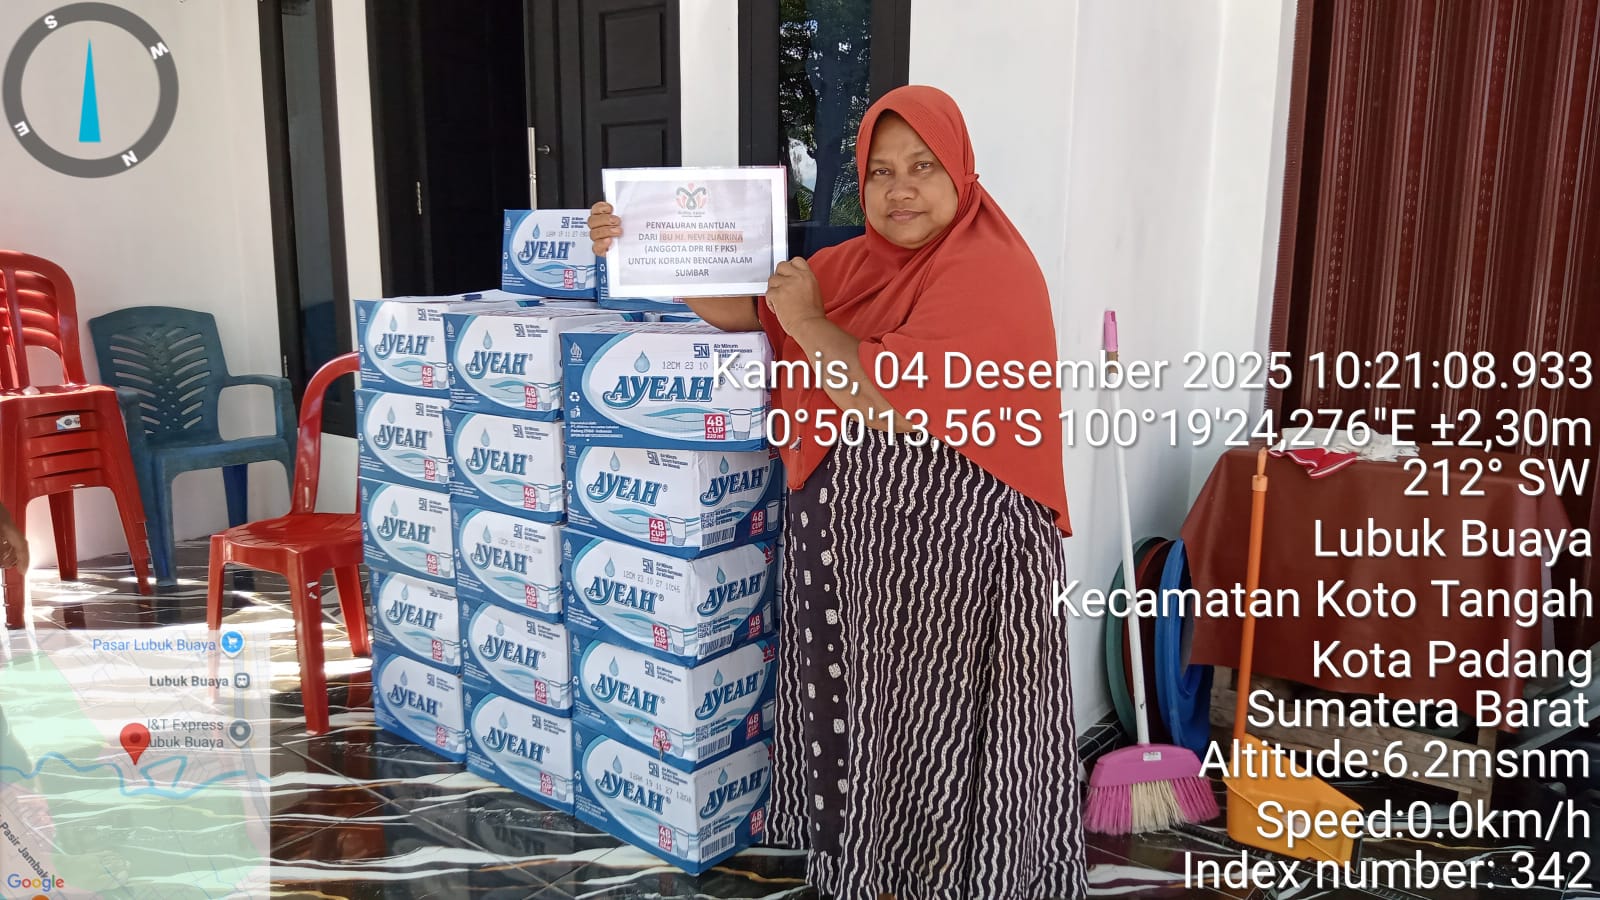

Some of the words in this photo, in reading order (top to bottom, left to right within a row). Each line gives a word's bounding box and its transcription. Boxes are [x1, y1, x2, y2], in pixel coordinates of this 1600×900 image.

[646, 221, 697, 230] PENYALURAN
[699, 221, 736, 230] BANTUAN
[638, 233, 658, 241] DARI
[518, 240, 571, 266] AYEAH
[644, 245, 687, 255] (ANGGOTA
[720, 245, 737, 255] PKS)
[628, 258, 657, 266] UNTUK
[658, 257, 691, 265] KORBAN
[693, 256, 729, 265] BENCANA
[731, 256, 753, 264] ALAM
[675, 268, 709, 278] SUMBAR
[374, 333, 430, 360] AYEAH
[693, 343, 710, 358] SNI
[422, 366, 432, 376] 48
[465, 351, 528, 379] AYEAH
[684, 361, 694, 370] 23
[699, 362, 708, 370] 10
[525, 387, 536, 397] 48
[602, 375, 714, 410] AYEAH
[706, 416, 723, 427] 48
[707, 426, 724, 434] CUP
[374, 424, 428, 450] AYEAH
[424, 460, 434, 470] 48
[466, 447, 528, 476] AYEAH
[524, 487, 535, 497] 48
[586, 471, 662, 507] AYEAH
[700, 466, 765, 507] AYEAH
[752, 511, 763, 522] 48
[377, 515, 431, 545] AYEAH
[650, 519, 664, 530] 48
[651, 529, 665, 538] CUP
[427, 555, 437, 565] 48
[470, 542, 528, 575] AYEAH
[525, 585, 536, 596] 48
[584, 575, 659, 615] AYEAH
[697, 573, 762, 617] AYEAH
[385, 599, 438, 631] AYEAH
[750, 614, 761, 626] 48
[654, 626, 666, 637] 48
[432, 640, 442, 650] 48
[479, 634, 541, 671] AYEAH
[535, 680, 546, 691] 48
[387, 684, 439, 717] AYEAH
[591, 673, 660, 716] AYEAH
[694, 672, 760, 721] AYEAH
[748, 713, 759, 726] 48
[482, 726, 545, 765] AYEAH
[541, 773, 552, 784] 48
[595, 769, 666, 815] AYEAH
[700, 768, 763, 820] AYEAH
[751, 809, 763, 822] 48
[659, 825, 671, 837] 48
